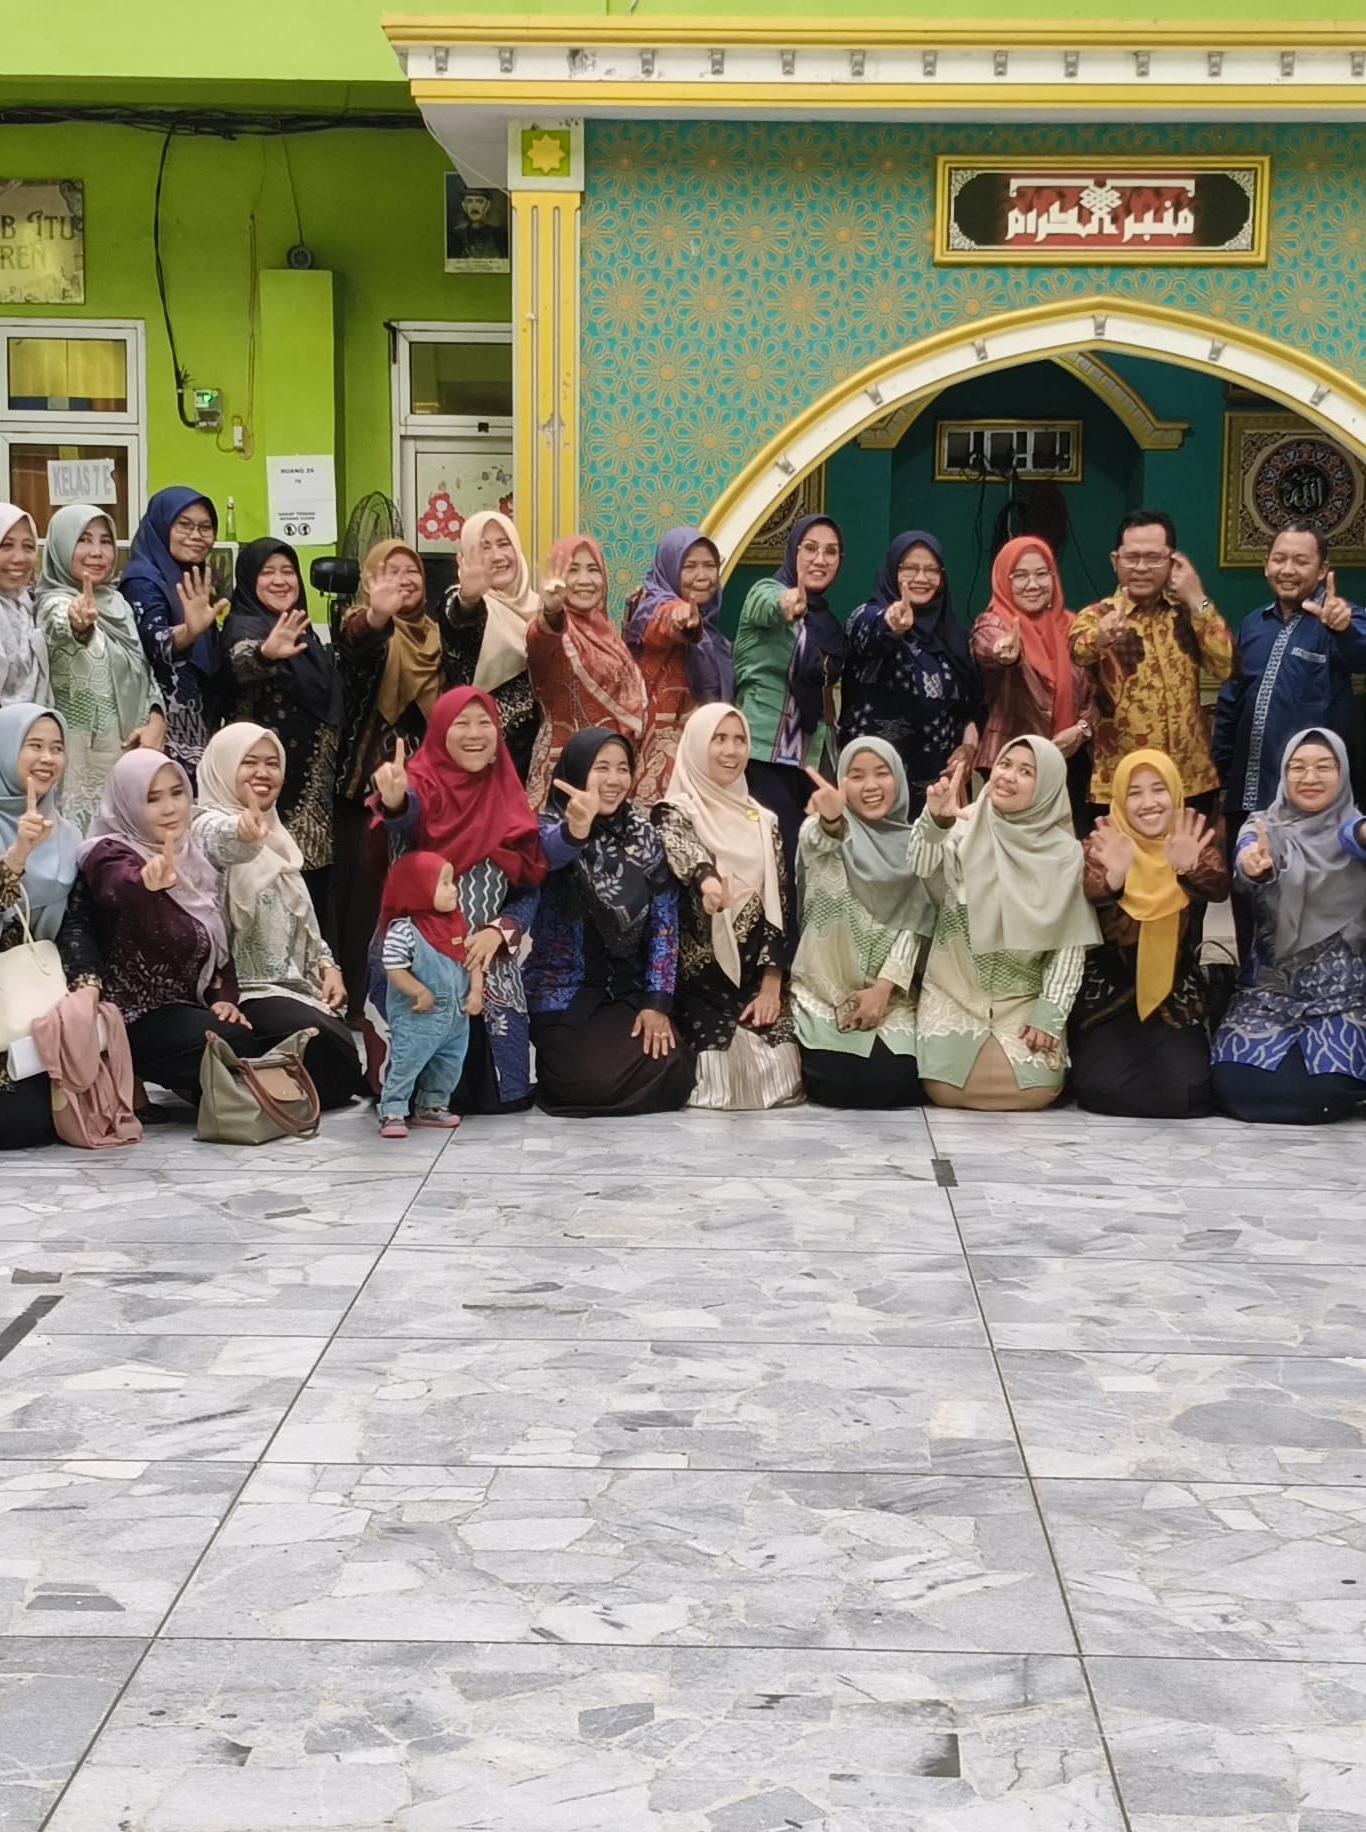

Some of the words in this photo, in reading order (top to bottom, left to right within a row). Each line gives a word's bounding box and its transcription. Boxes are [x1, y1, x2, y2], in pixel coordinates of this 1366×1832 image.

[27, 210, 76, 241] ITU
[52, 465, 91, 497] KELAS
[92, 465, 100, 496] 7
[102, 465, 113, 496] E
